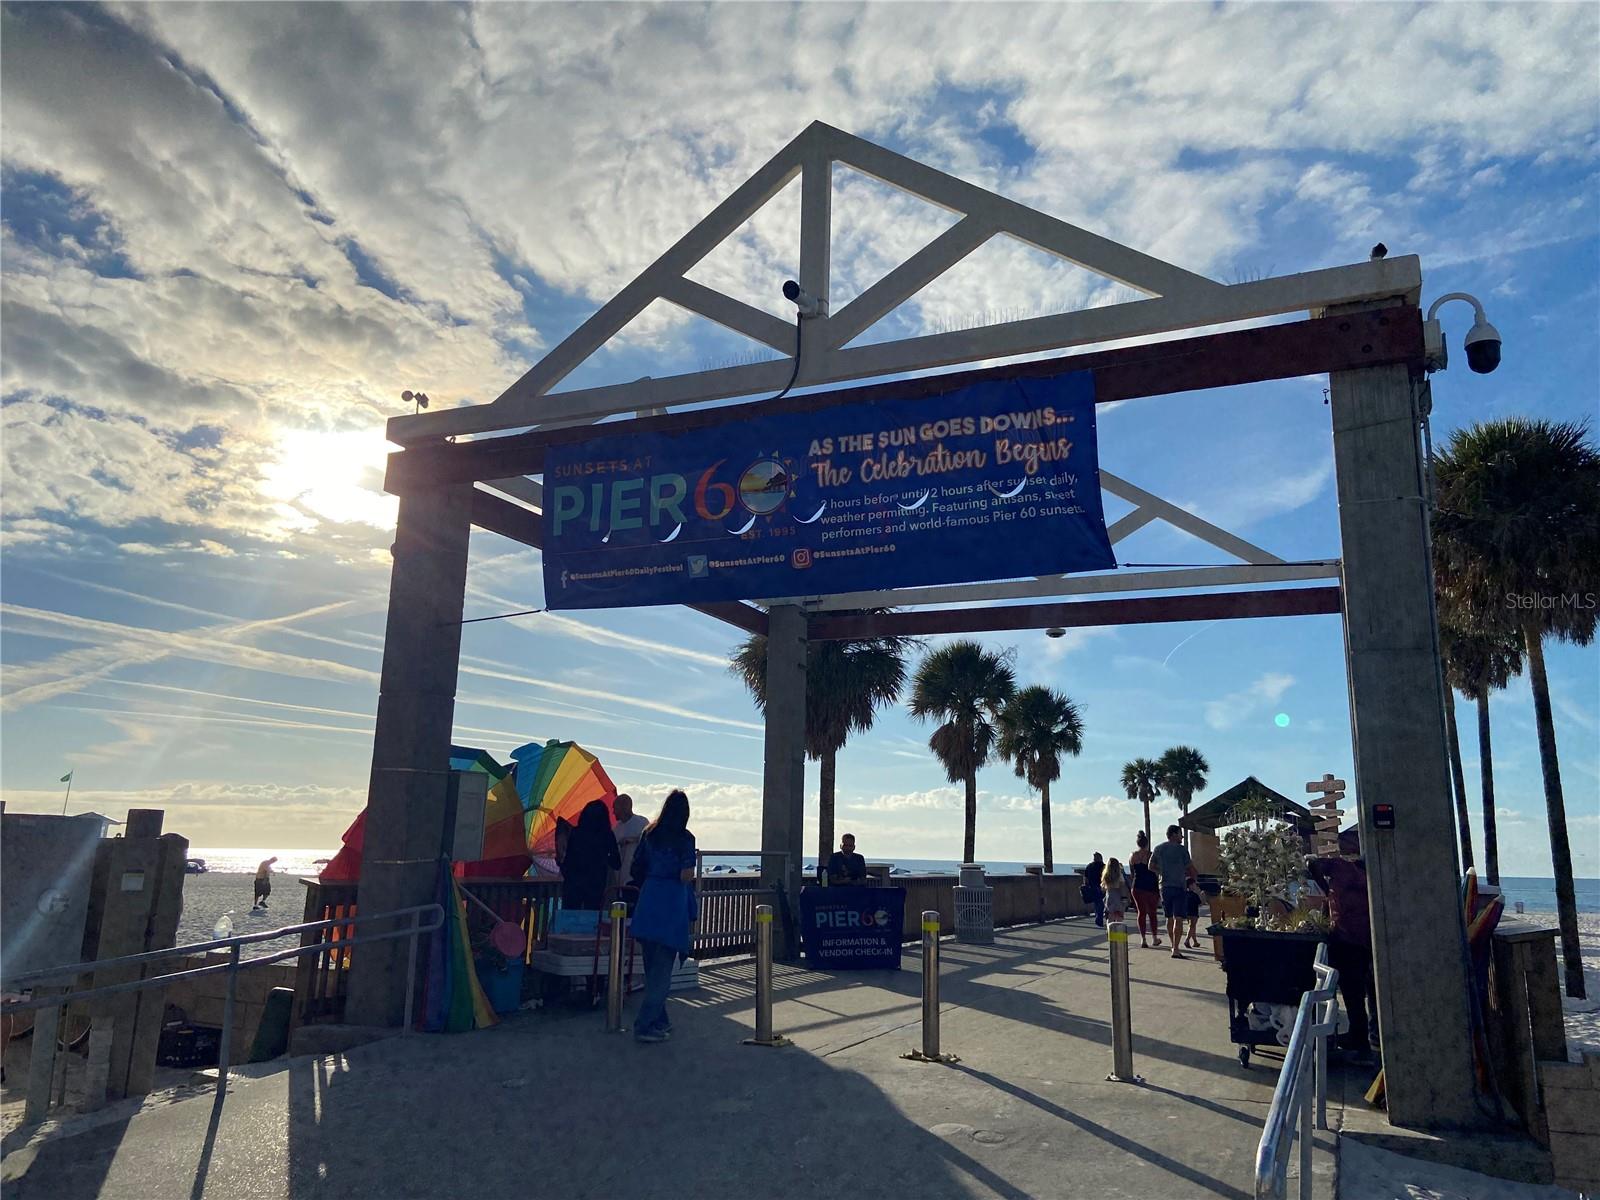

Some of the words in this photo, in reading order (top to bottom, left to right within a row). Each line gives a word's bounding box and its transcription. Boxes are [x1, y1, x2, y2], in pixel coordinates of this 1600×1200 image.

[808, 438, 833, 457] AS
[838, 432, 875, 453] THE
[878, 426, 916, 448] SUN
[919, 416, 976, 441] GOES
[554, 457, 628, 478] SUNSETS
[633, 455, 653, 470] AT
[811, 459, 852, 488] The
[860, 443, 988, 483] Celebration
[995, 438, 1074, 474] Begins
[830, 497, 862, 509] hours
[930, 487, 938, 499] 2
[941, 484, 974, 498] hours
[976, 479, 1004, 492] after
[1049, 471, 1079, 487] daily,
[820, 511, 866, 525] weather
[868, 503, 930, 523] permitting.
[932, 497, 988, 514] Featuring
[991, 491, 1042, 507] artisans,
[821, 524, 882, 542] performers
[884, 521, 907, 534] and
[909, 513, 990, 531] world-famous
[993, 508, 1017, 522] Pier
[1020, 506, 1037, 519] 60
[708, 553, 786, 569] @SunsetsAtPier60
[813, 543, 897, 560] @SunsetsAtPier60
[818, 948, 853, 959] VENDOR
[854, 947, 893, 958] CHECK-IN
[822, 937, 879, 948] INFORMATION
[881, 937, 887, 946] &
